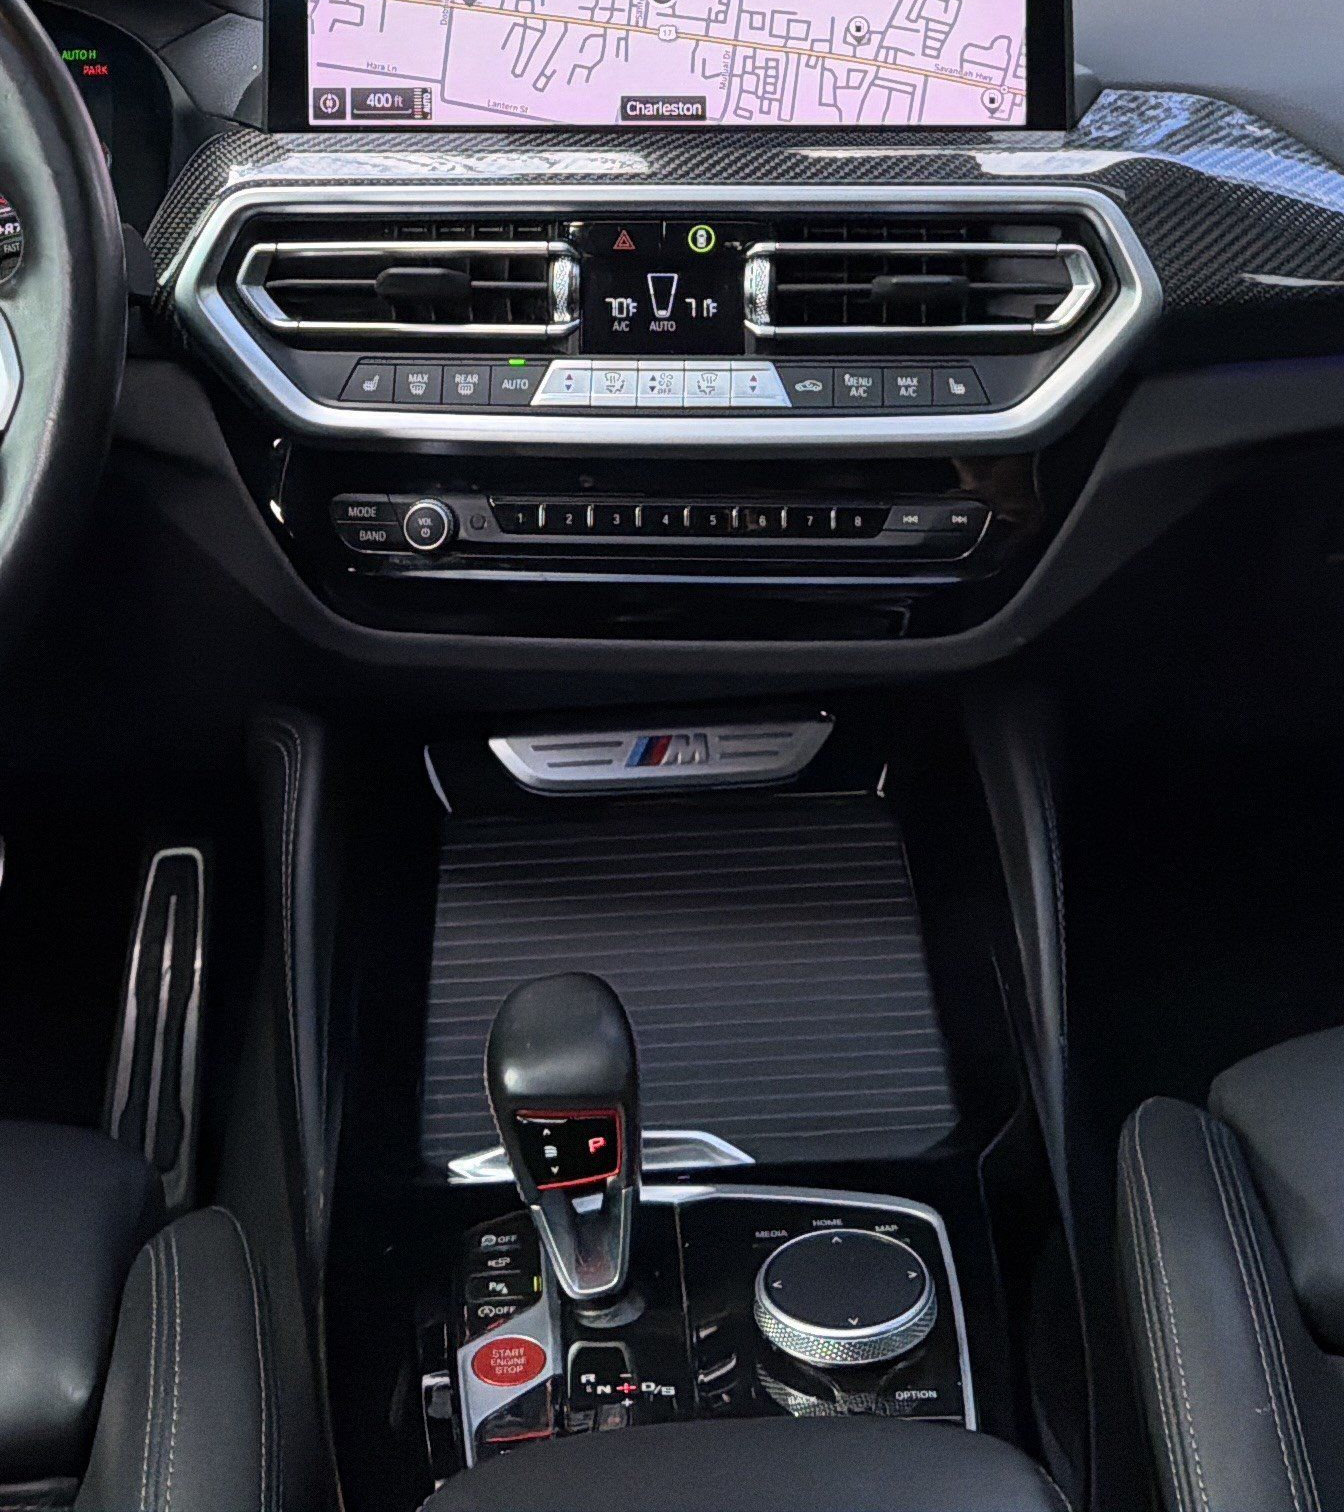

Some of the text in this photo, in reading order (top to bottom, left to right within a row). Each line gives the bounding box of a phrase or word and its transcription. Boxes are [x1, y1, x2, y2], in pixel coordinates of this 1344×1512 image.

[662, 28, 673, 37] 17
[62, 49, 97, 61] AUTO H
[83, 64, 109, 76] PARK
[719, 60, 731, 91] Mutual
[975, 72, 994, 84] Hwy
[365, 92, 404, 108] 400 ft
[487, 99, 529, 114] Lantern St
[626, 100, 703, 117] Charleston
[612, 320, 676, 332] A/C AUTO
[408, 373, 429, 383] MAX
[455, 373, 479, 384] REAR
[845, 376, 873, 387] MENU
[897, 376, 919, 387] MAX
[501, 378, 529, 390] AUTO
[849, 387, 868, 398] A/C
[899, 387, 917, 398] A/C
[348, 506, 377, 518] MODE
[418, 517, 434, 527] VOL
[517, 512, 862, 527] 1 2 3 4 5 6 7 8
[359, 530, 387, 542] BAND
[588, 1136, 607, 1154] P
[812, 1218, 843, 1227] HOME
[874, 1224, 898, 1232] MAP
[755, 1229, 788, 1238] MEDIA
[497, 1235, 517, 1244] OFF
[495, 1305, 516, 1314] OFF
[492, 1347, 525, 1358] START
[495, 1364, 524, 1375] STOP
[580, 1373, 596, 1384] R
[596, 1384, 612, 1395] N
[895, 1390, 938, 1400] OPTION
